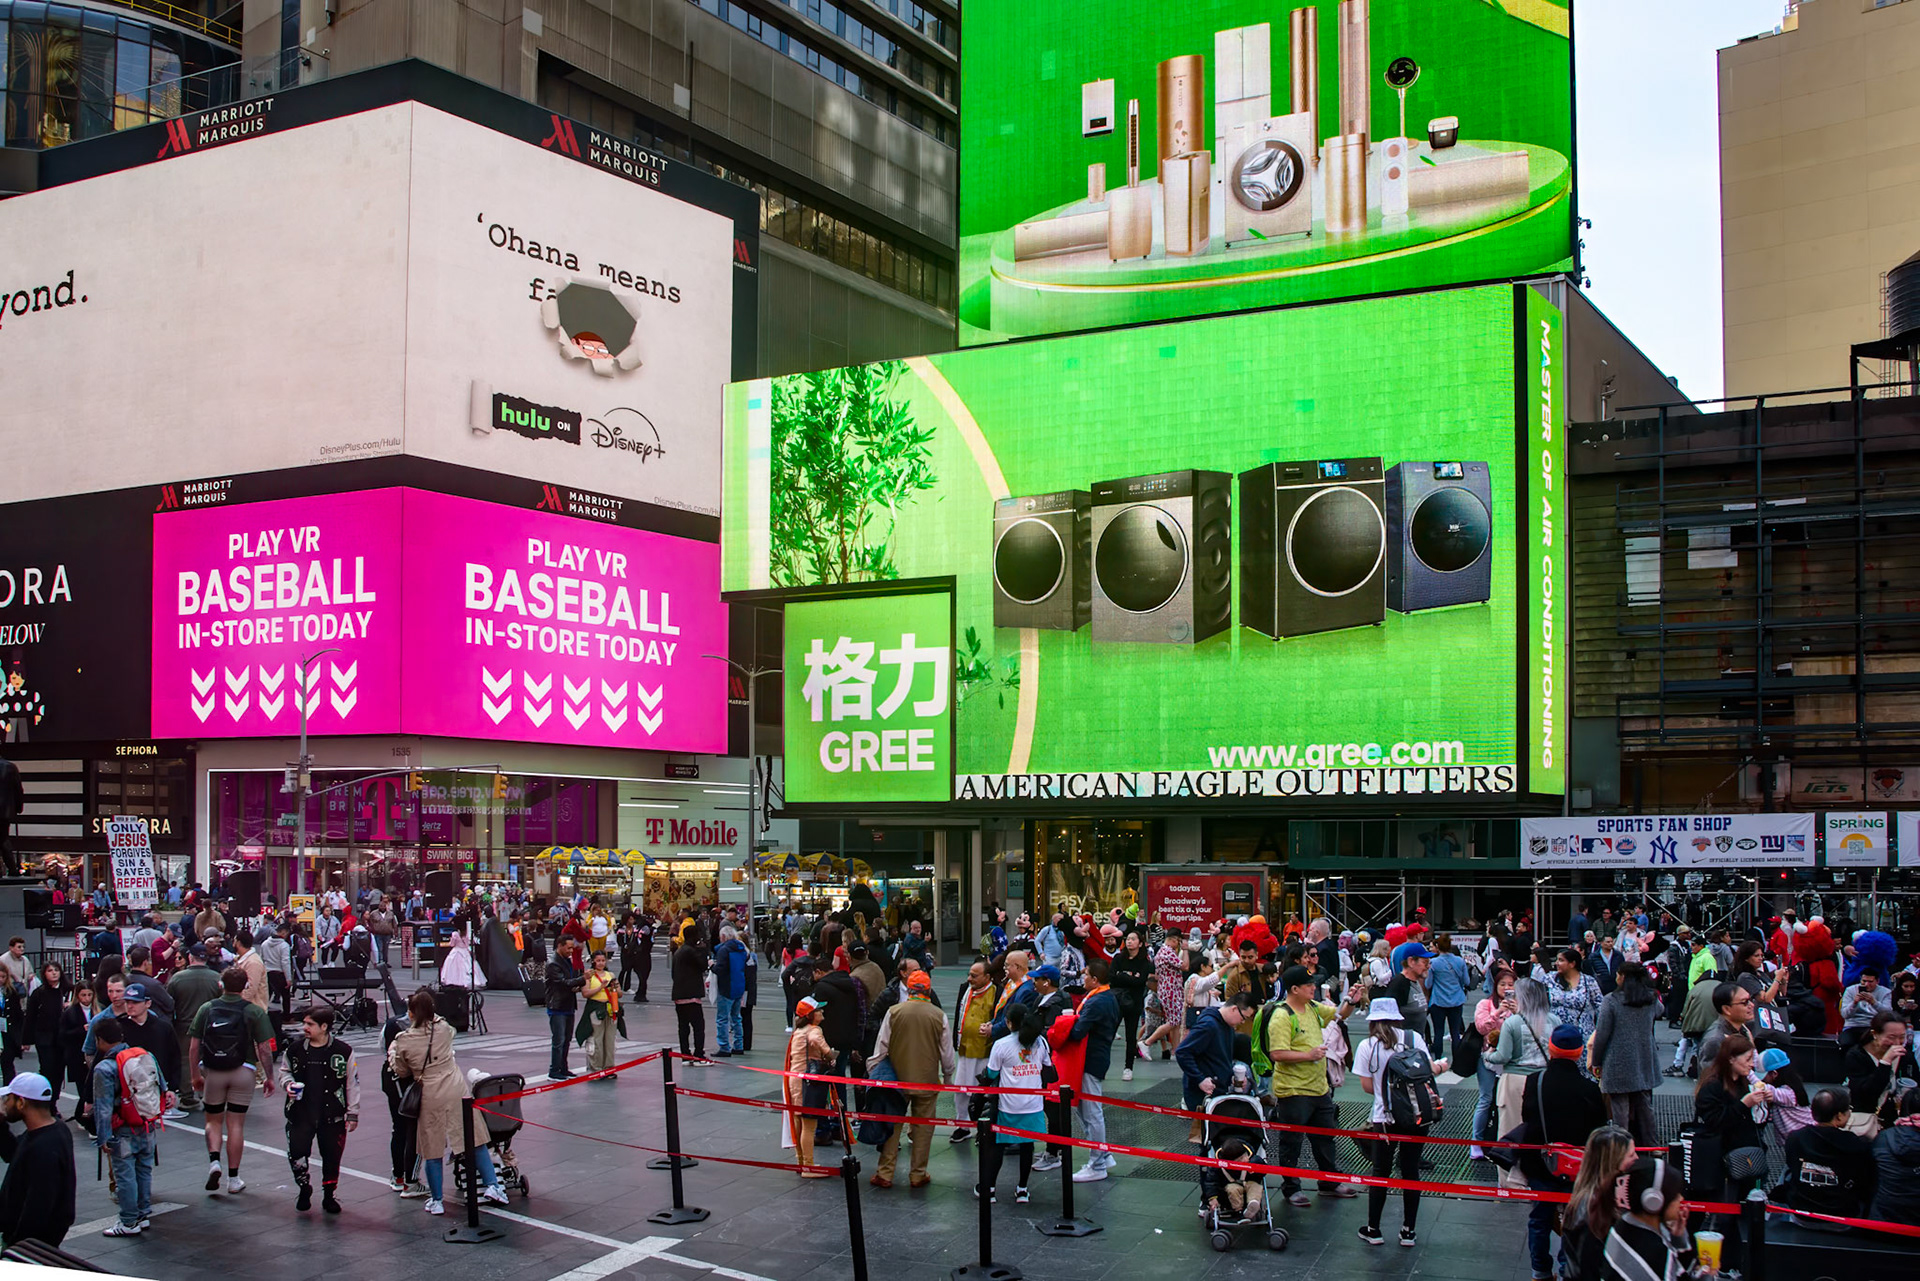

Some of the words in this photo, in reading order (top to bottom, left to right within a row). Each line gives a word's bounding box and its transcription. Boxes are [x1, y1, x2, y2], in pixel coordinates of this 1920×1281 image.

[200, 98, 274, 127] MARRIOTT
[199, 119, 265, 145] MARQUIS
[590, 131, 669, 172] MARRIOTT
[589, 148, 660, 186] MARQUIS
[599, 262, 681, 304] means
[1540, 319, 1552, 442] MASTER
[501, 402, 551, 432] hulu
[557, 421, 571, 433] ON
[587, 416, 667, 464] Disney+
[320, 438, 401, 456] DisneyPlus.com/Hulu
[1541, 448, 1552, 492] OF
[183, 478, 233, 494] MARRIOTT
[183, 492, 227, 506] MARQUIS
[569, 490, 624, 510] MARRIOTT
[569, 503, 618, 520] MARQUIS
[1541, 496, 1553, 548] AIR
[228, 528, 285, 560] PLAY
[289, 525, 321, 553] VR
[527, 537, 590, 572] PLAY
[595, 549, 628, 579] VR
[178, 556, 376, 616] BASEBALL
[465, 562, 681, 637] BASEBALL
[178, 616, 284, 649] IN-STORE
[288, 611, 373, 643] TODAY
[465, 616, 590, 658] IN-STORE
[595, 633, 677, 667] TODAY
[1541, 555, 1554, 770] CONDITIONING
[801, 633, 950, 722] 格力
[116, 745, 158, 756] SEPHORA
[391, 747, 411, 757] 1535
[819, 728, 935, 773] GREE
[1208, 740, 1464, 769] www.gree.com
[959, 772, 1139, 799] AMERICAN
[1152, 769, 1264, 798] EAGLE
[1276, 766, 1514, 797] OUTFITTERS
[1796, 781, 1850, 793] JETS
[111, 823, 143, 833] ONLY
[669, 818, 738, 846] Mobile
[1598, 819, 1653, 833] SPORTS
[1658, 818, 1688, 832] FAN
[1694, 817, 1733, 831] SHOP
[110, 848, 152, 858] FORGIVES
[112, 833, 147, 847] JESUS
[118, 859, 135, 867] SIN
[139, 859, 146, 867] &
[457, 851, 474, 860] BIG!
[116, 868, 151, 877] SAVES
[117, 877, 154, 889] REPENT
[1049, 890, 1086, 912] Easy
[1164, 896, 1206, 906] Broadway's
[1169, 885, 1201, 893] todaytix
[1158, 905, 1174, 913] best
[1175, 905, 1185, 913] tix
